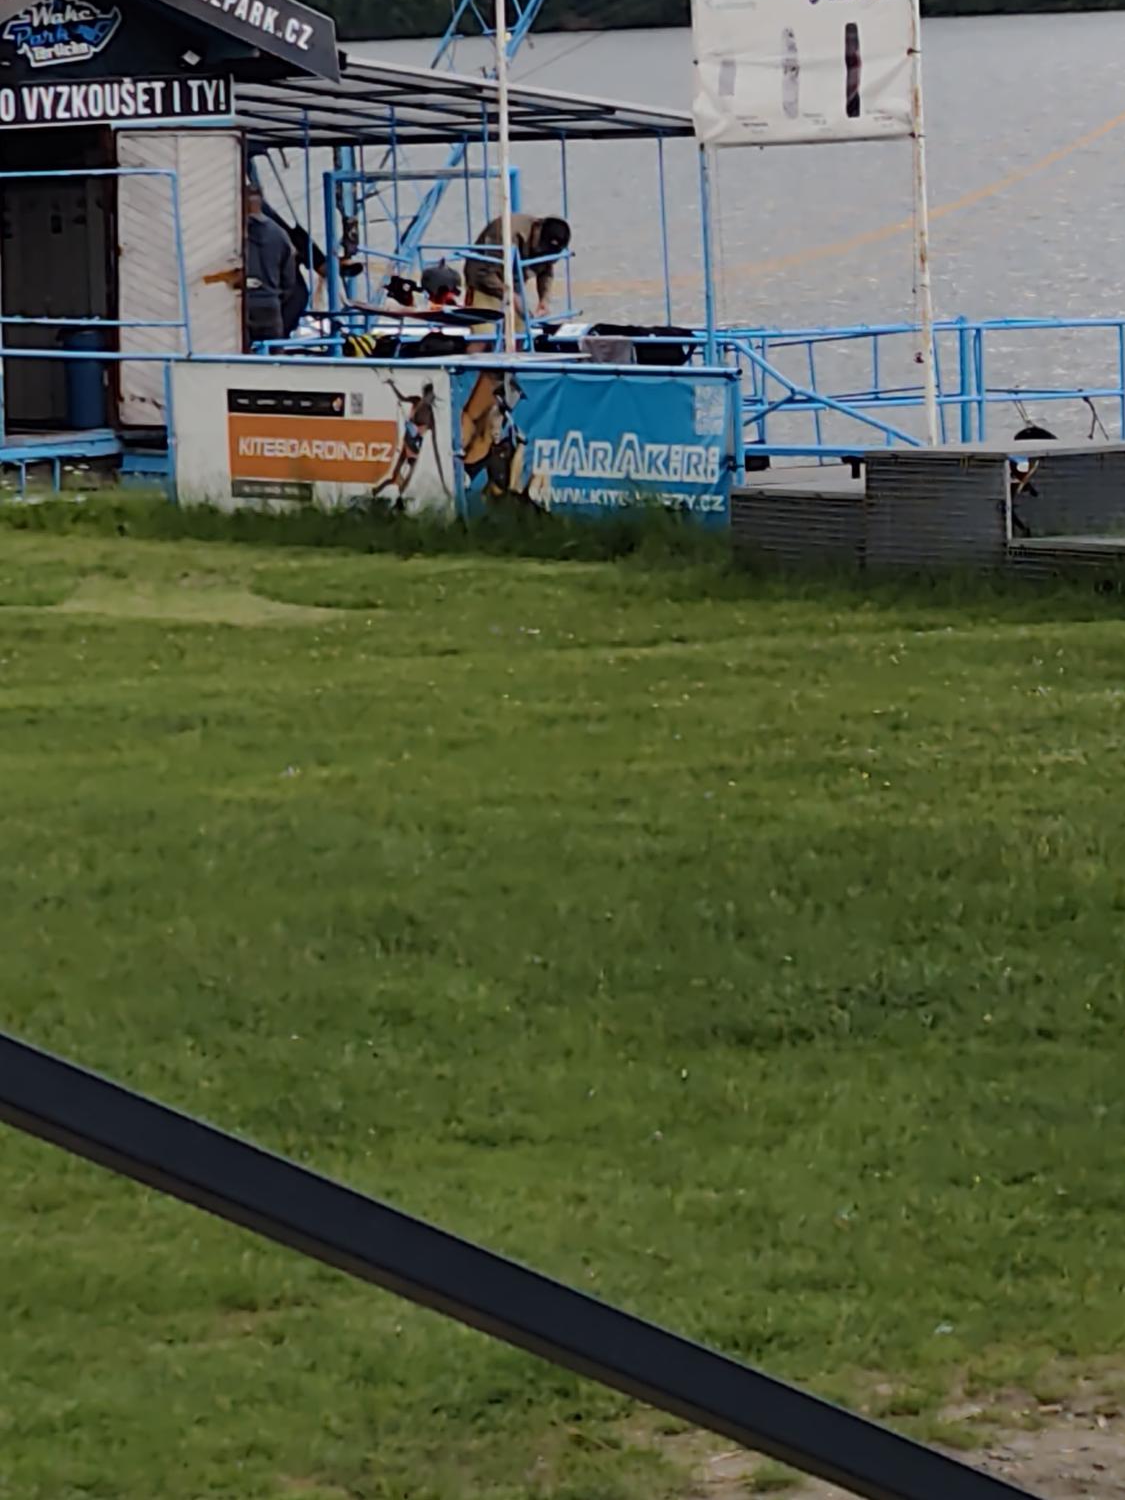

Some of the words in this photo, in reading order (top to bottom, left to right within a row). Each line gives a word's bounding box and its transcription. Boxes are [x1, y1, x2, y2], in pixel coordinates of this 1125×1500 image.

[21, 77, 166, 120] VYZKOUŠET
[172, 80, 181, 113] I
[187, 79, 226, 112] TY!
